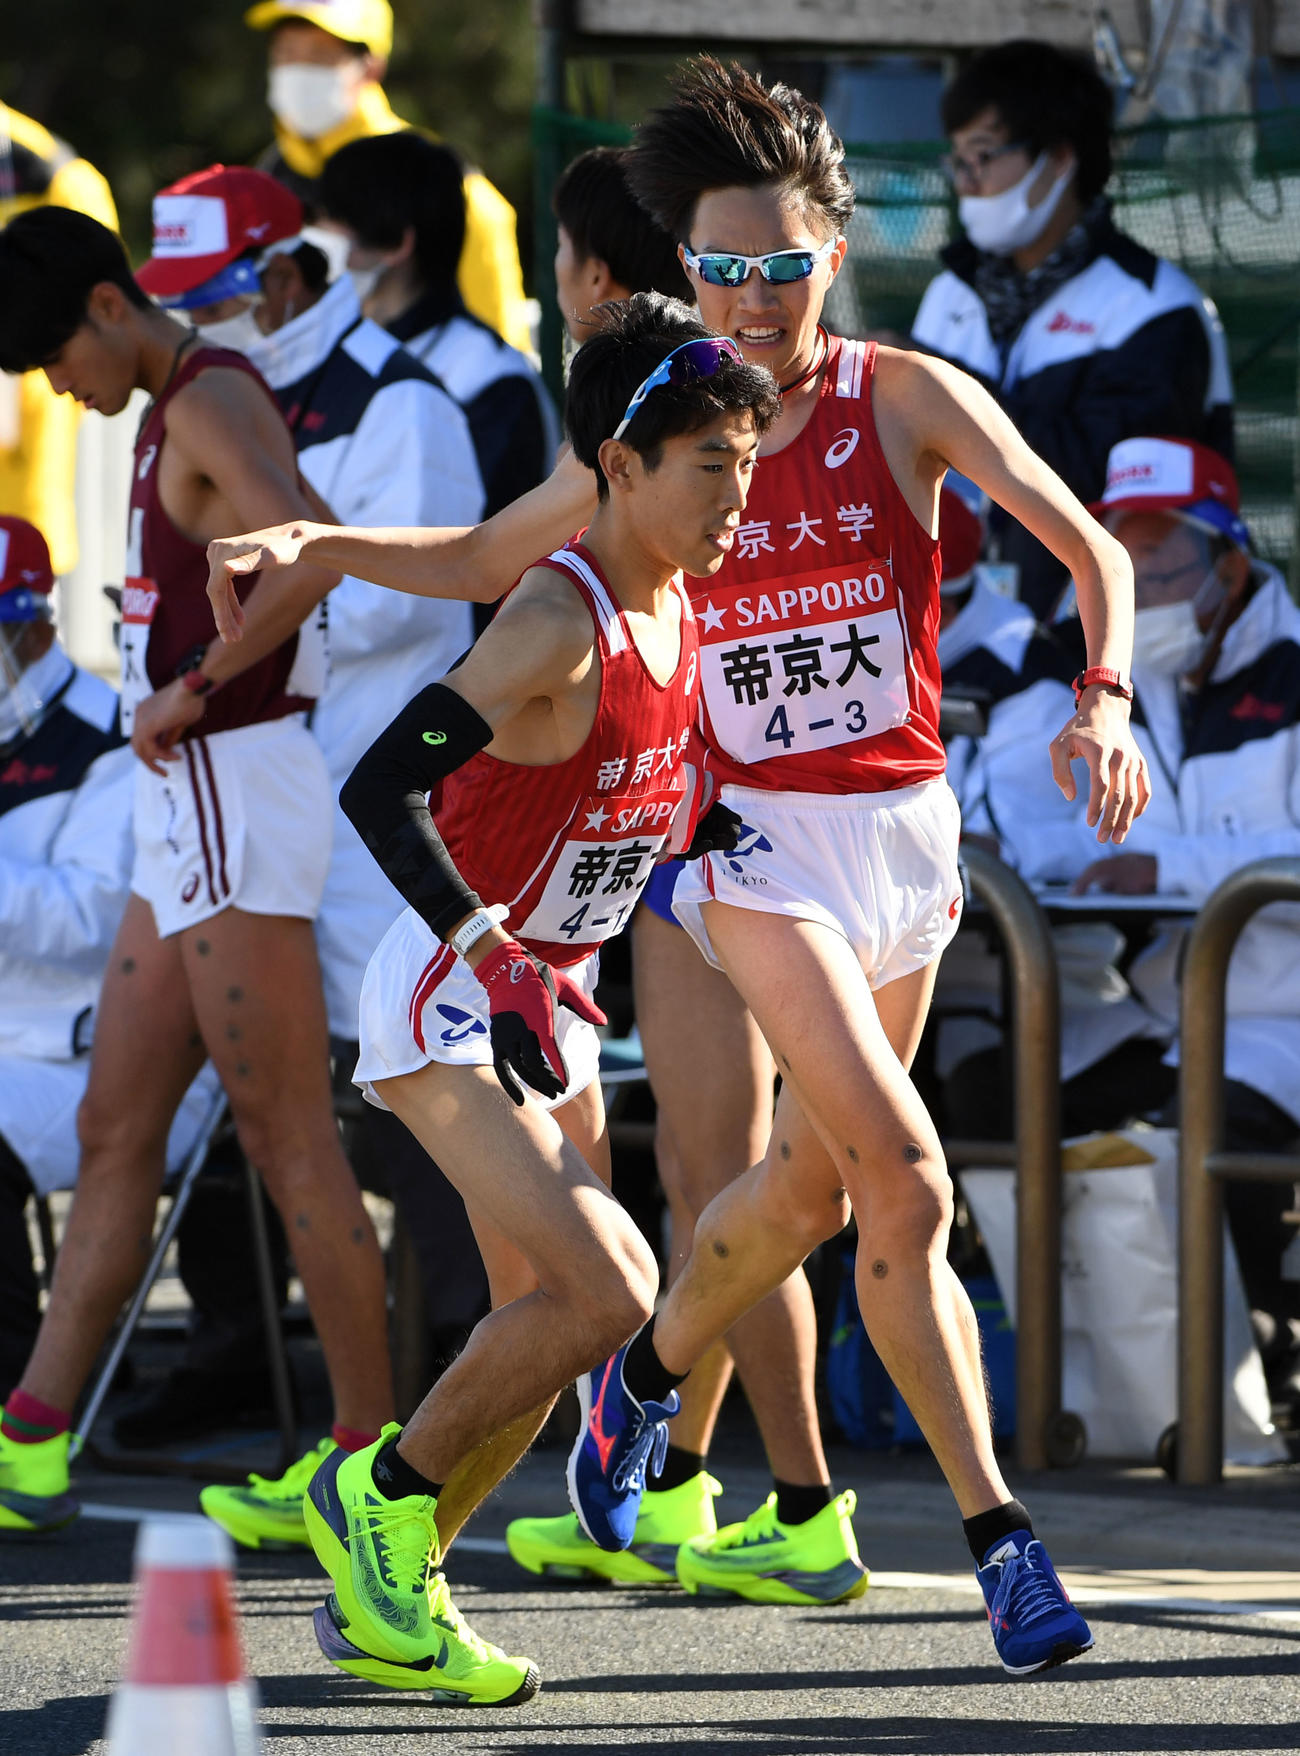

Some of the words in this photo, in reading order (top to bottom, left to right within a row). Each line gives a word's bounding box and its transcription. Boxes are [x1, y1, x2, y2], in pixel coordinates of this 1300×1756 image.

[734, 502, 875, 560] 京大学
[734, 572, 886, 627] SAPPORO
[719, 623, 882, 706] 帝京大
[567, 839, 661, 899] 帝京
